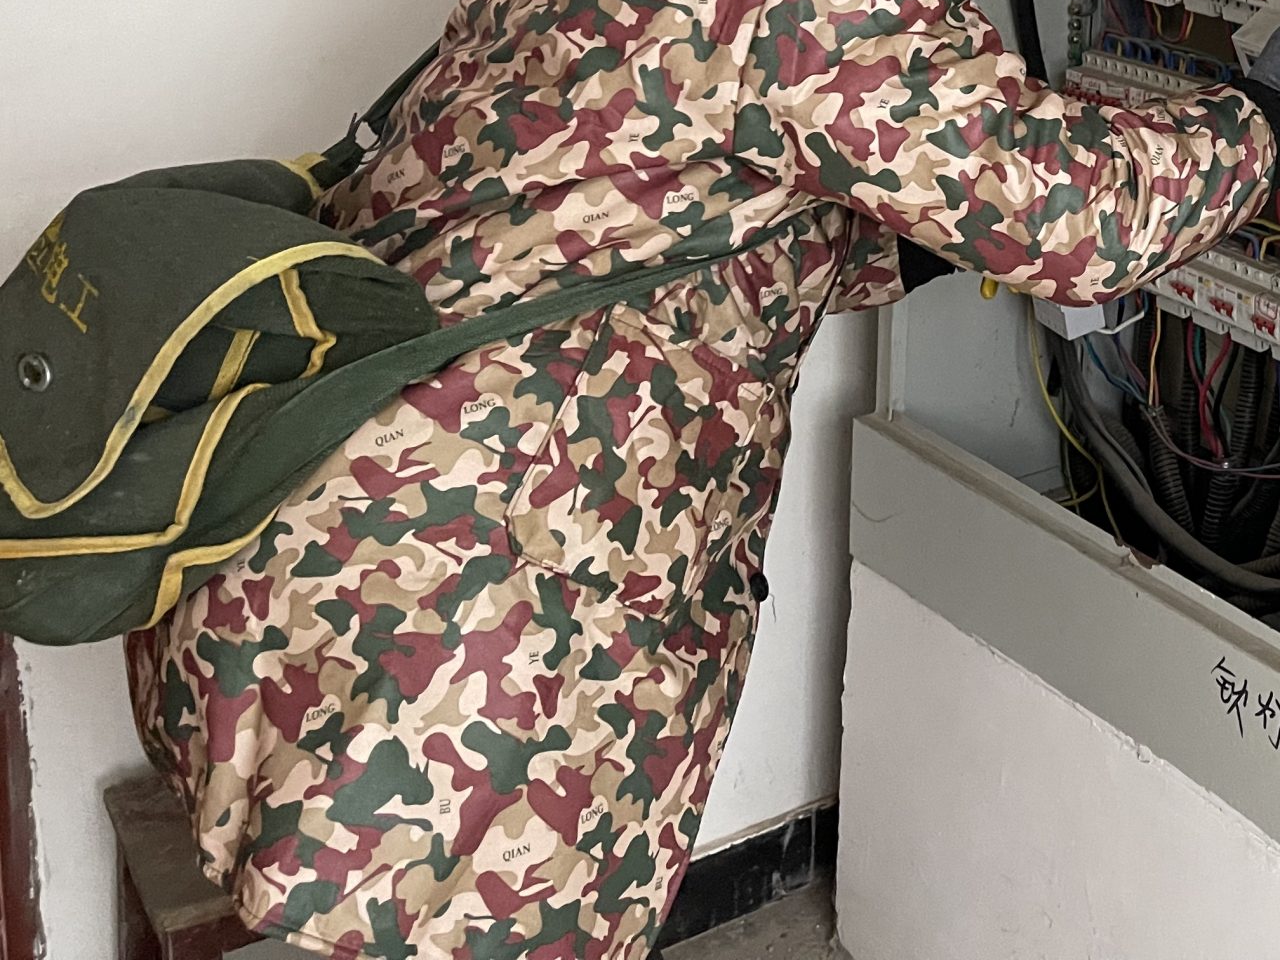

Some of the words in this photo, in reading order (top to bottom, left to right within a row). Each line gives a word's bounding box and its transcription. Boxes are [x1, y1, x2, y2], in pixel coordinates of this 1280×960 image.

[877, 98, 890, 109] YE
[444, 144, 466, 158] LONG
[1150, 144, 1164, 166] QIAN
[667, 192, 695, 204] LONG
[582, 211, 610, 224] QIAN
[760, 287, 783, 300] LONG
[463, 398, 496, 415] LONG
[374, 428, 405, 447] QIAN
[528, 650, 540, 666] YE
[305, 702, 336, 723] LONG
[439, 798, 451, 815] BU
[580, 803, 604, 825] LONG
[502, 843, 531, 863] QIAN
